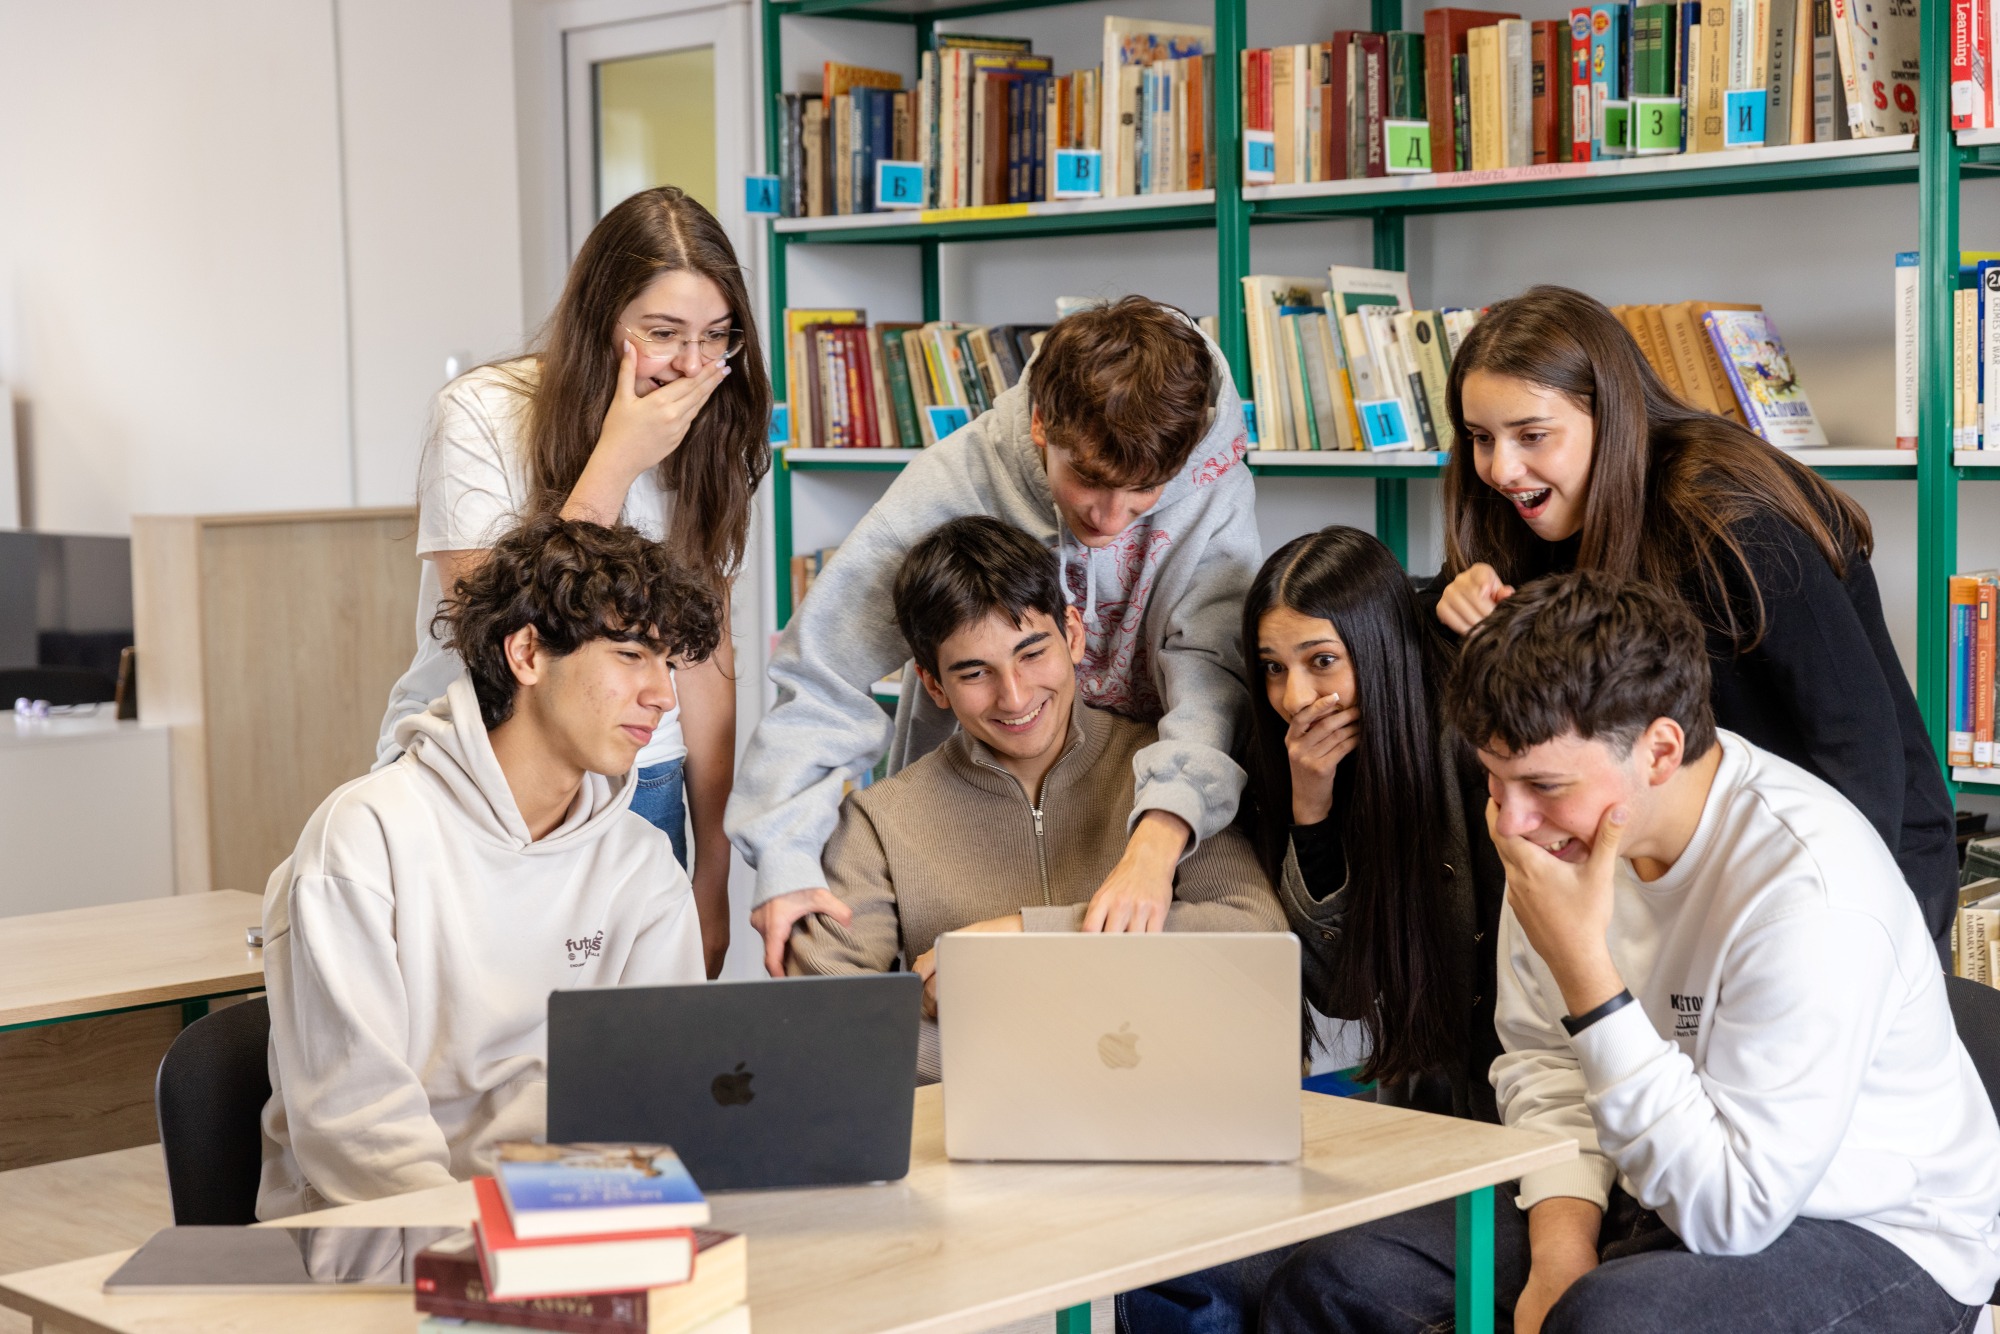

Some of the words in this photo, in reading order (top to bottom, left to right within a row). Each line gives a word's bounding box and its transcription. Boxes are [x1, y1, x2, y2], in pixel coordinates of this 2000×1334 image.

[1954, 3, 1970, 67] Learning
[1772, 28, 1783, 106] ПОВЕСТИ
[1367, 53, 1380, 164] ГУСИ-ЛЕБЕДИ
[1738, 105, 1752, 132] И
[1406, 136, 1423, 166] Д
[1076, 157, 1089, 179] В
[1516, 163, 1562, 178] RUSSIAN
[759, 186, 771, 207] А
[893, 177, 907, 197] Б
[1992, 297, 2000, 330] CRIMES
[1676, 321, 1695, 371] ПУШКИН
[1992, 333, 2000, 343] OF
[1904, 334, 1914, 376] HUMAN
[1992, 345, 2000, 365] WAR
[1904, 377, 1914, 415] RIGHTS
[1979, 650, 1987, 681] CRITICAL
[1978, 684, 1987, 720] STRATEGIES
[1966, 914, 1975, 950] BARBARA
[1976, 923, 1985, 962] DISTANT
